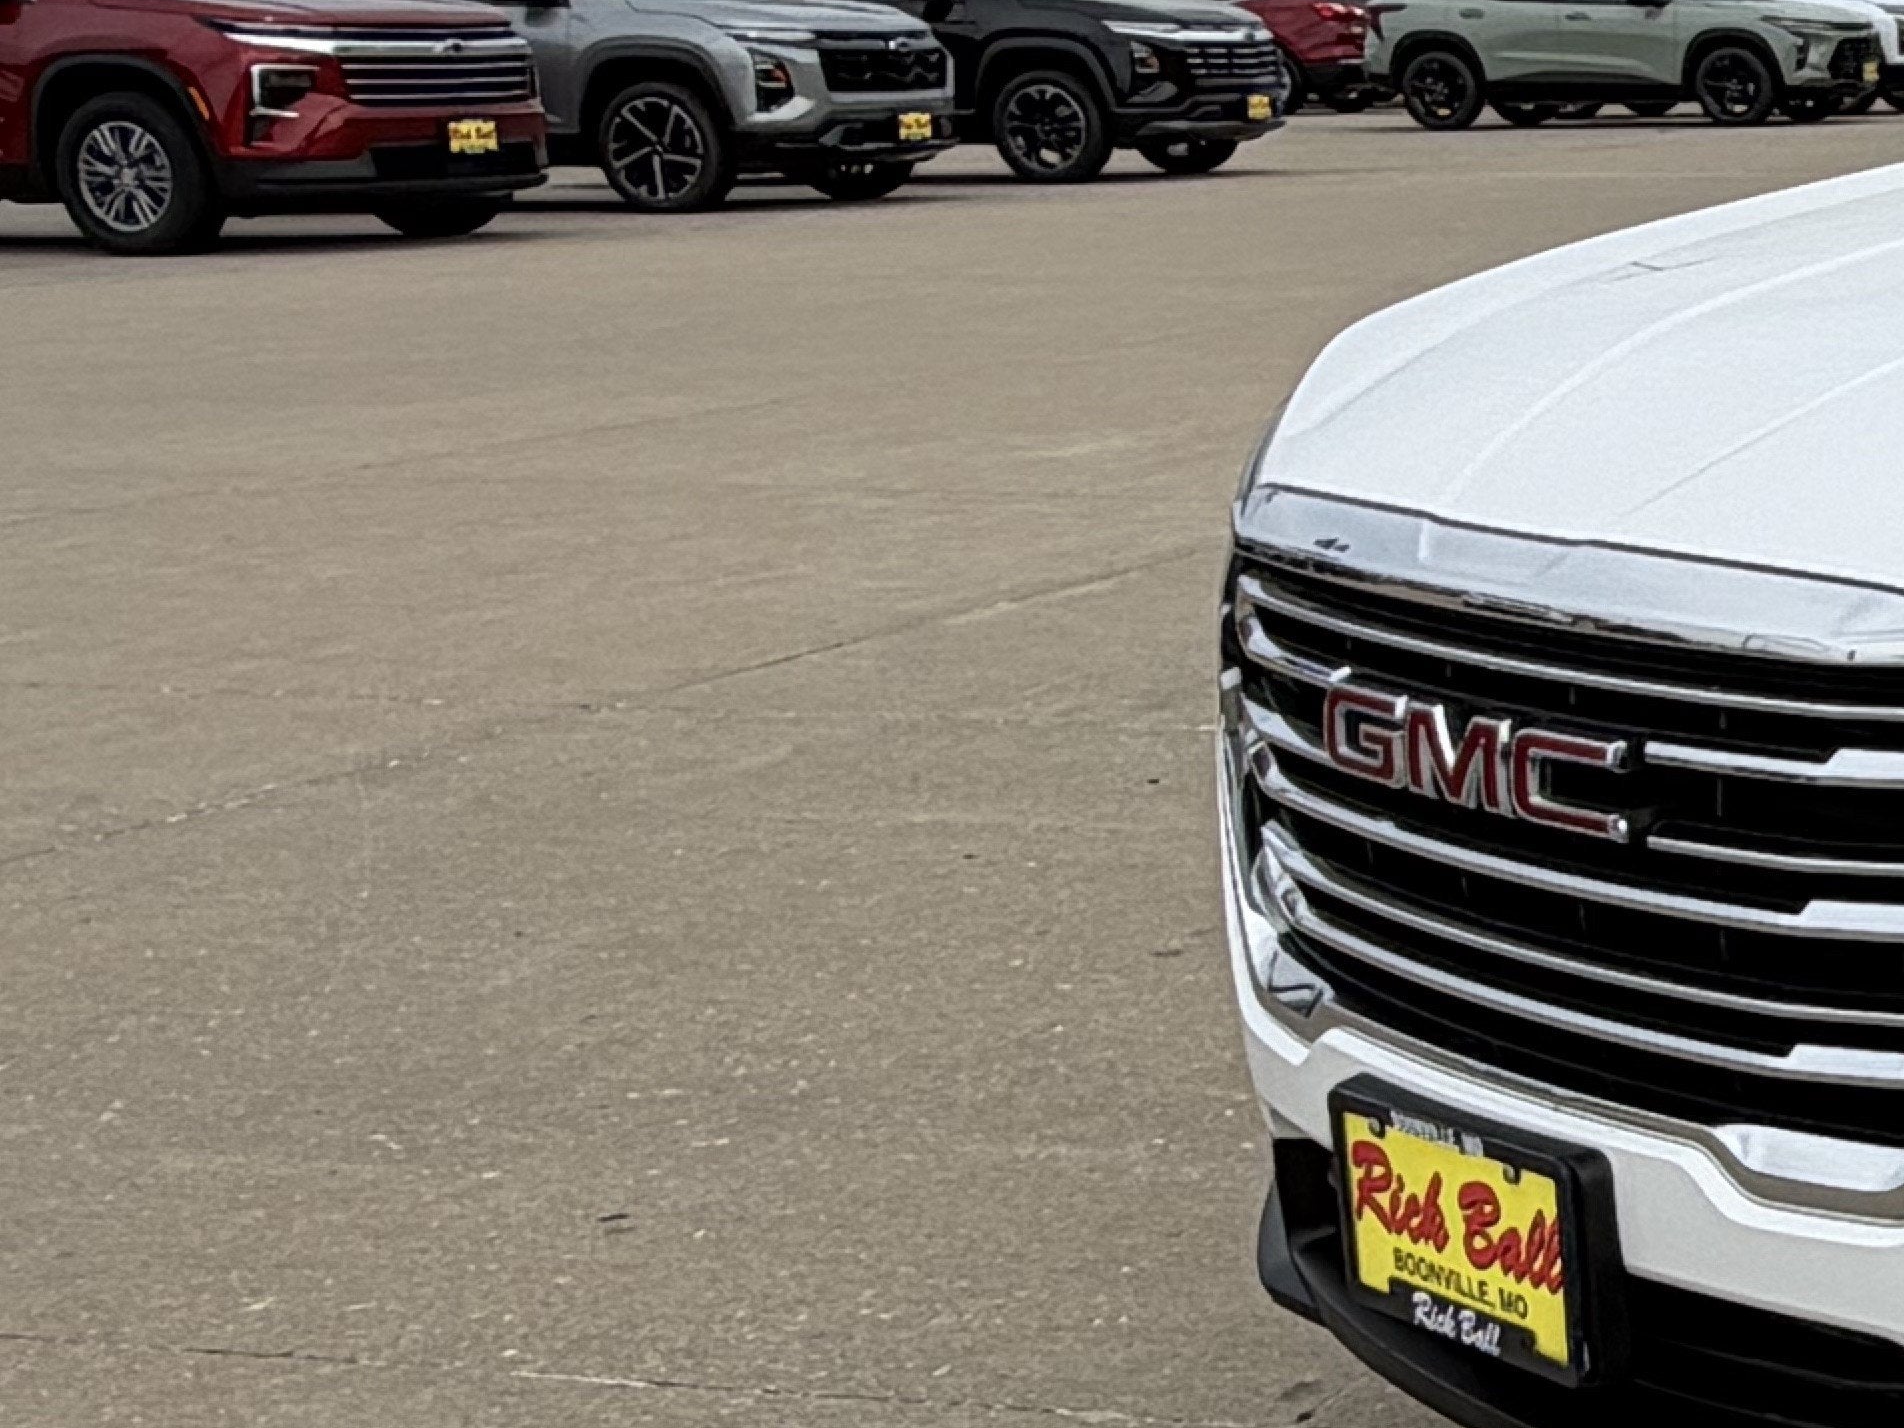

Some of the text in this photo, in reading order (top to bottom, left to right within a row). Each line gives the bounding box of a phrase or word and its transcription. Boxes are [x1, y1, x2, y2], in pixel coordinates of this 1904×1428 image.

[1323, 681, 1629, 843] GMC
[1351, 1139, 1564, 1295] Rick Ball
[1412, 1291, 1501, 1357] Rick Ball
[1499, 1286, 1529, 1320] MO
